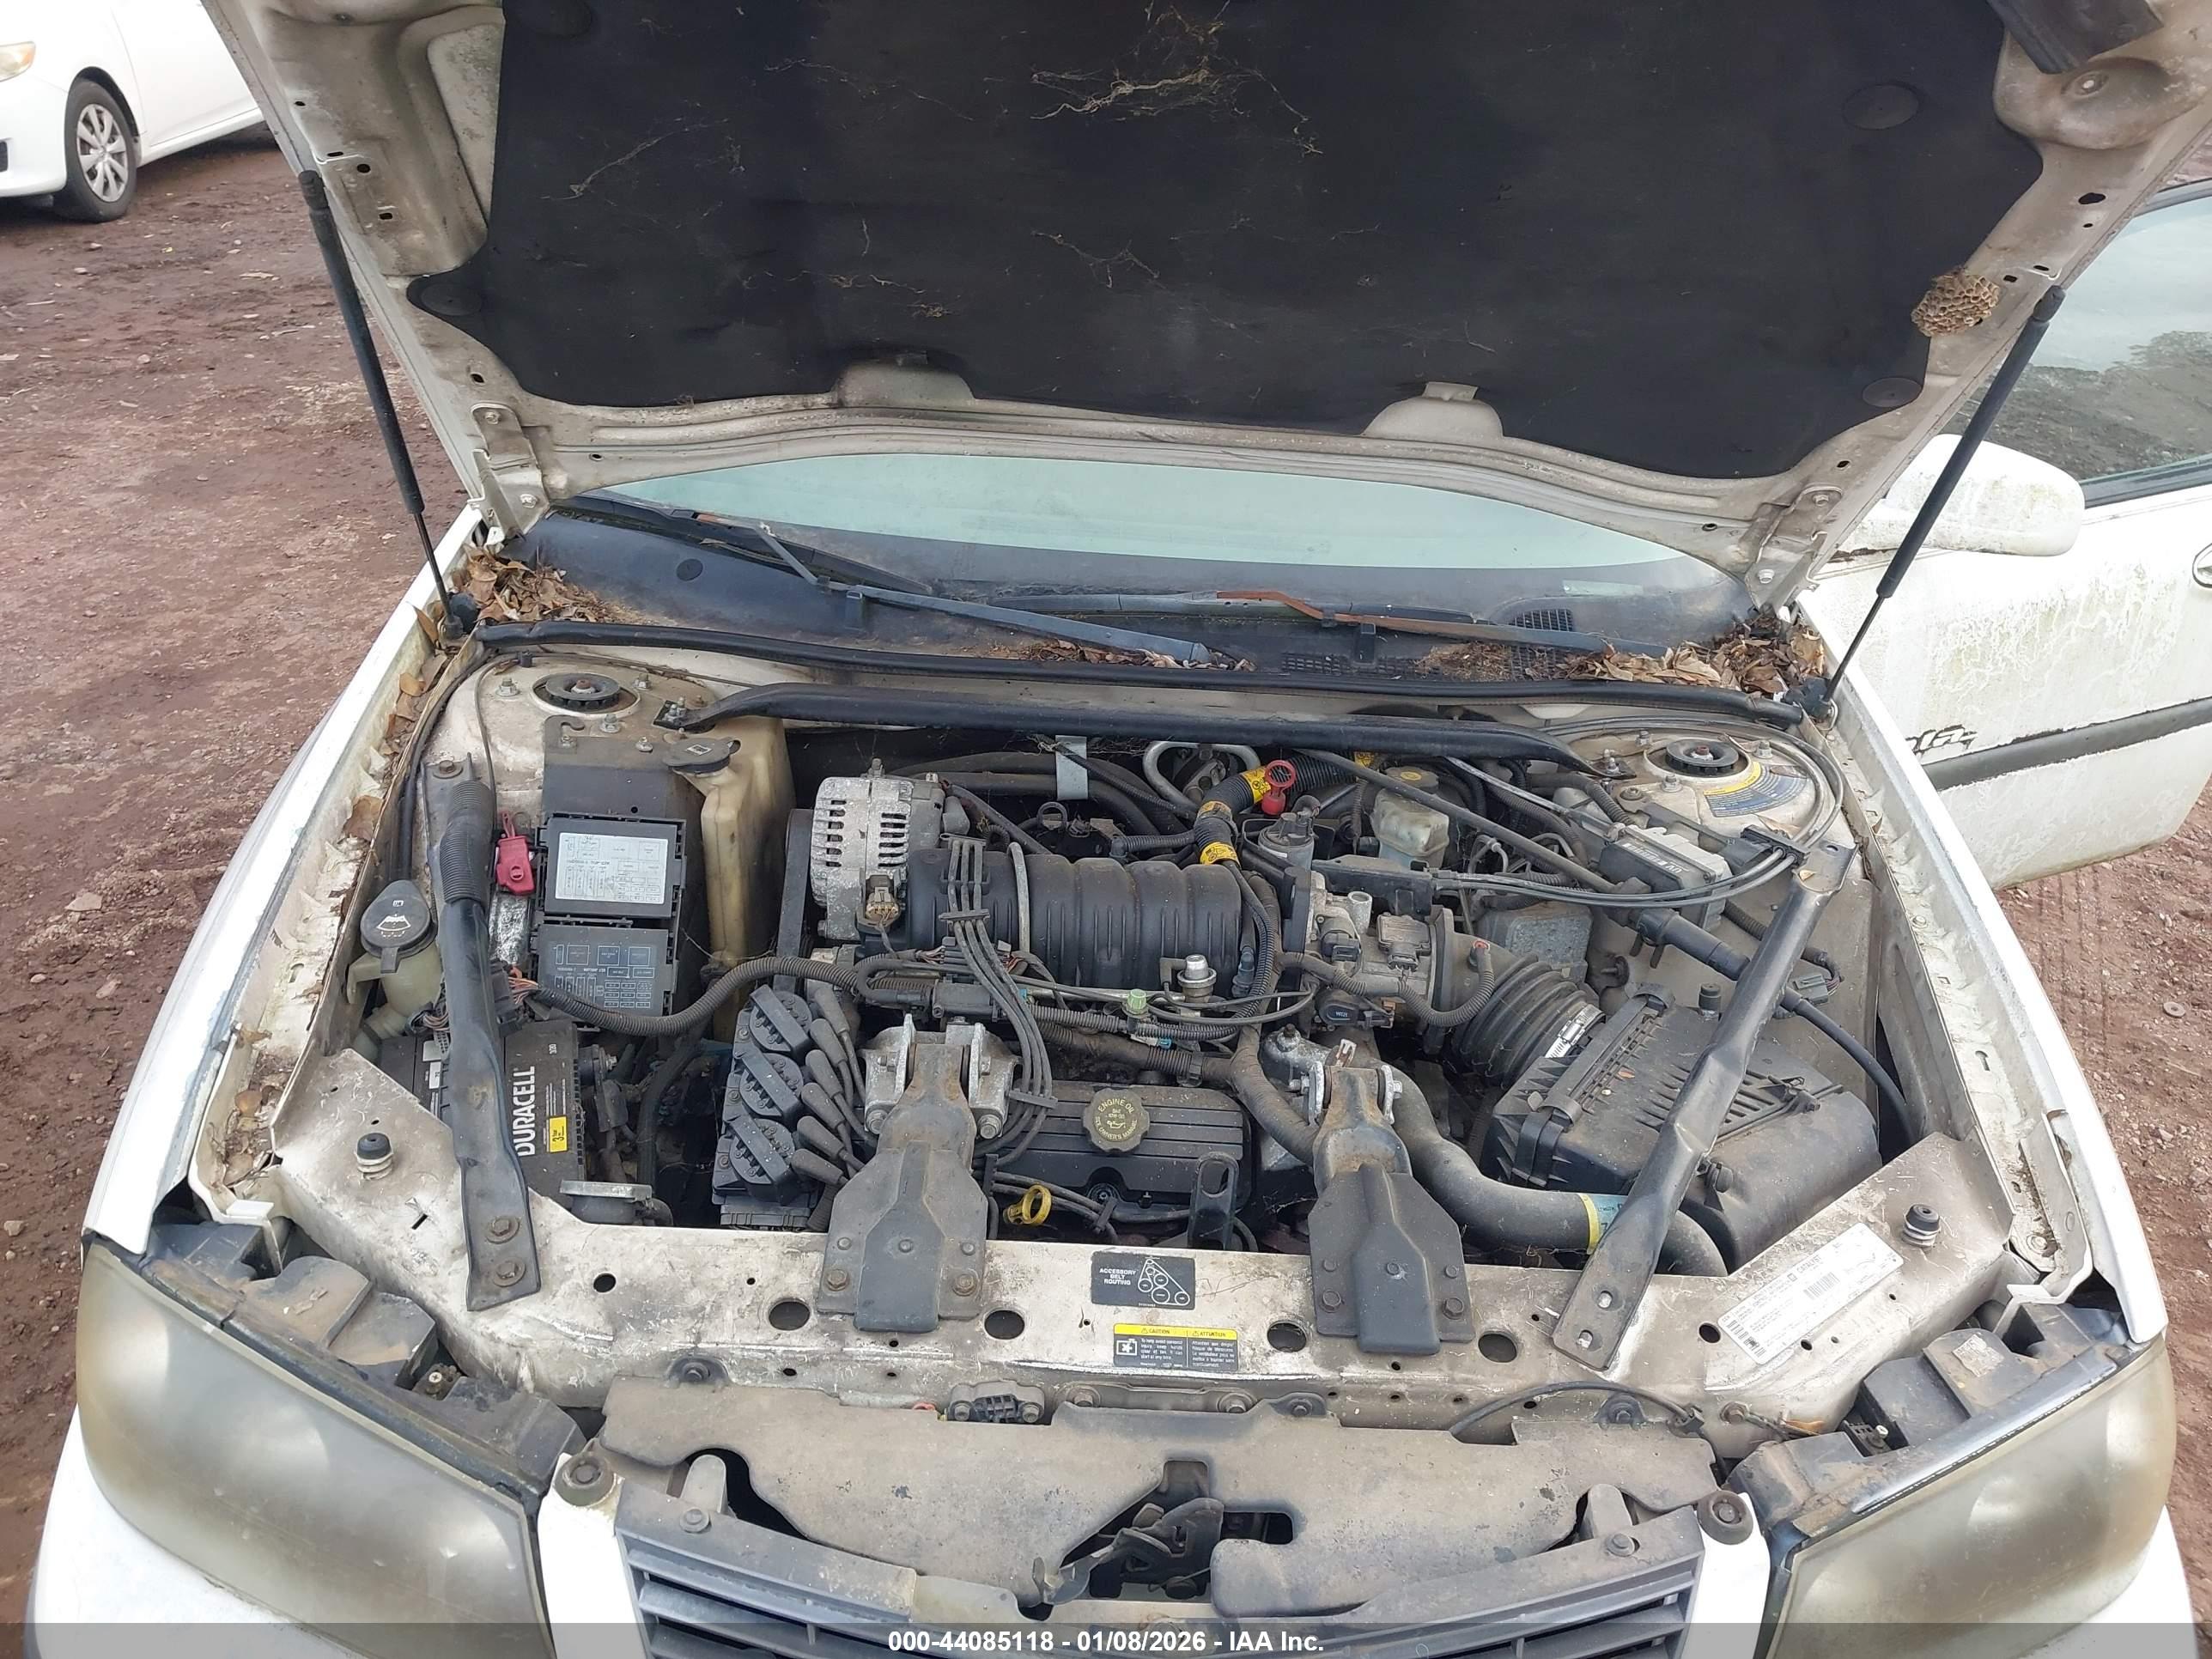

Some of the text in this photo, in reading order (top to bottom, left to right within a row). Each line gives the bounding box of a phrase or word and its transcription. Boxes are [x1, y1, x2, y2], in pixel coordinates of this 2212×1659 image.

[513, 1066, 536, 1157] DURACELL
[1098, 1098, 1134, 1114] ENGINE OIL
[1099, 1267, 1136, 1276] ACCESSORY
[1796, 1255, 1821, 1274] CATALYST
[1103, 1278, 1131, 1286] ROUTING
